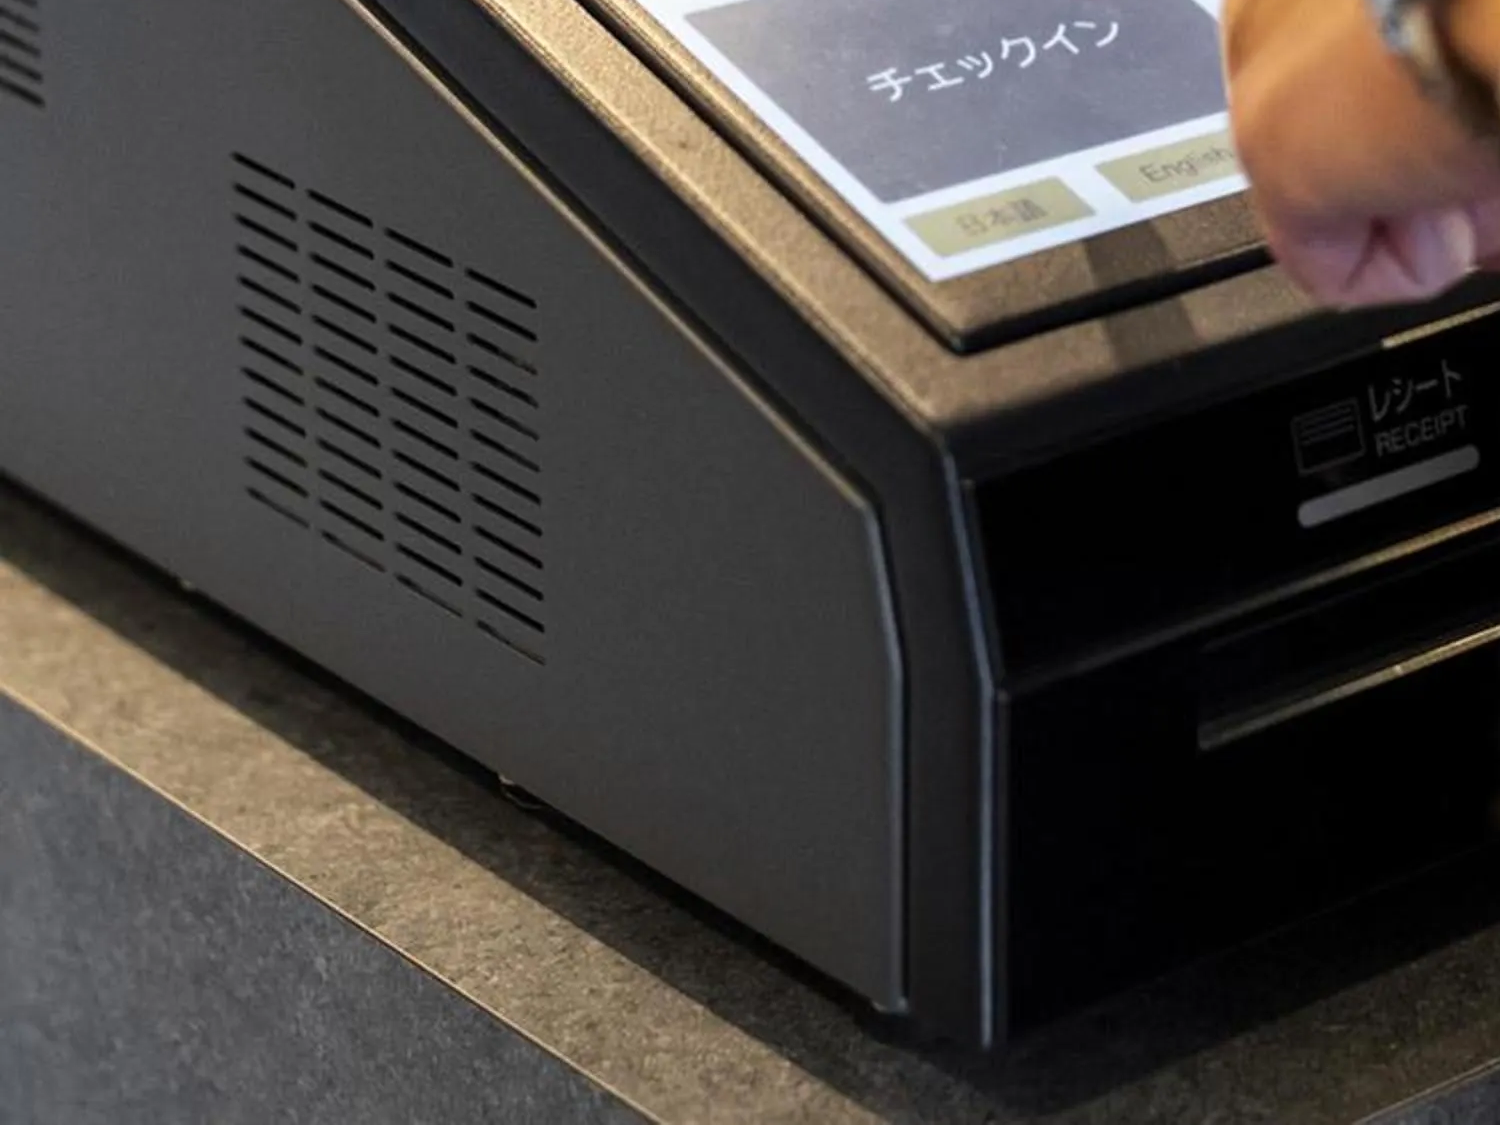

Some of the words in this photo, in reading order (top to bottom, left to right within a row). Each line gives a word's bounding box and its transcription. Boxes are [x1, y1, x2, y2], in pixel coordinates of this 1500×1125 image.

[867, 21, 1119, 102] チェックイン
[955, 197, 1048, 237] 日本語
[1367, 359, 1462, 422] レシート
[1374, 404, 1469, 457] RECEIPT
